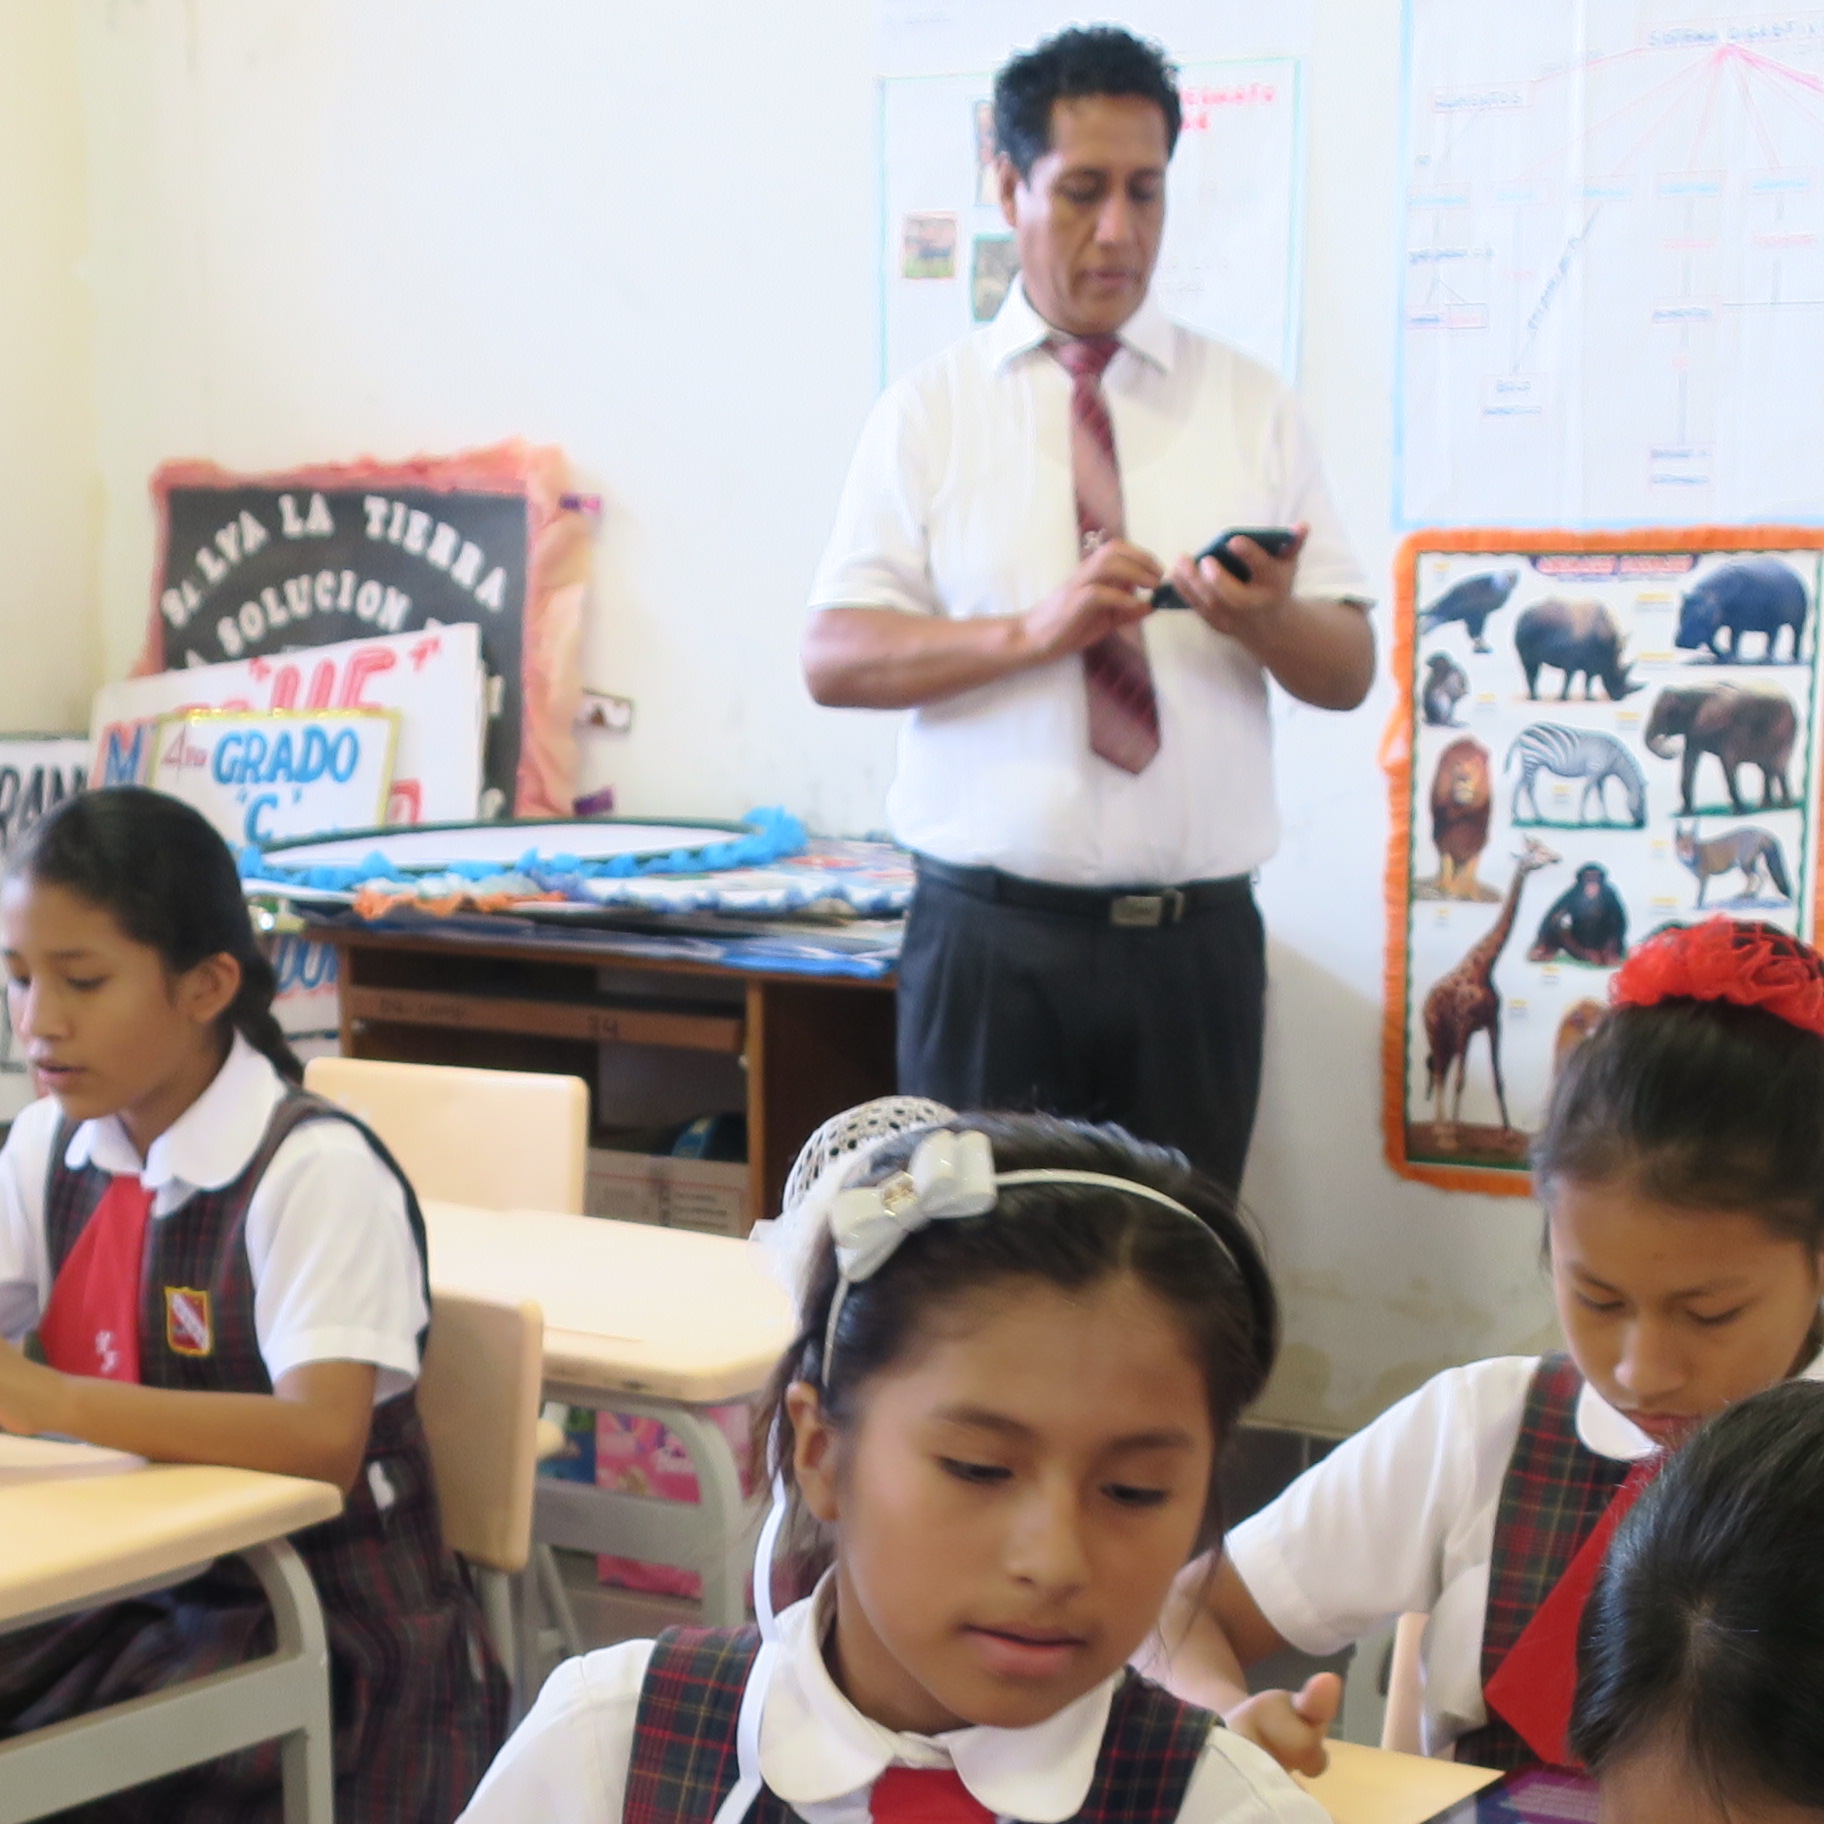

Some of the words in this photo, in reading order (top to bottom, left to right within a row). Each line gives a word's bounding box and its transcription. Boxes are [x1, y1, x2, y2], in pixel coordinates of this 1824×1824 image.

[278, 494, 334, 538] LA
[363, 494, 507, 612] TIERRA
[216, 568, 412, 656] SOLUCION
[213, 725, 360, 784] GRADO
